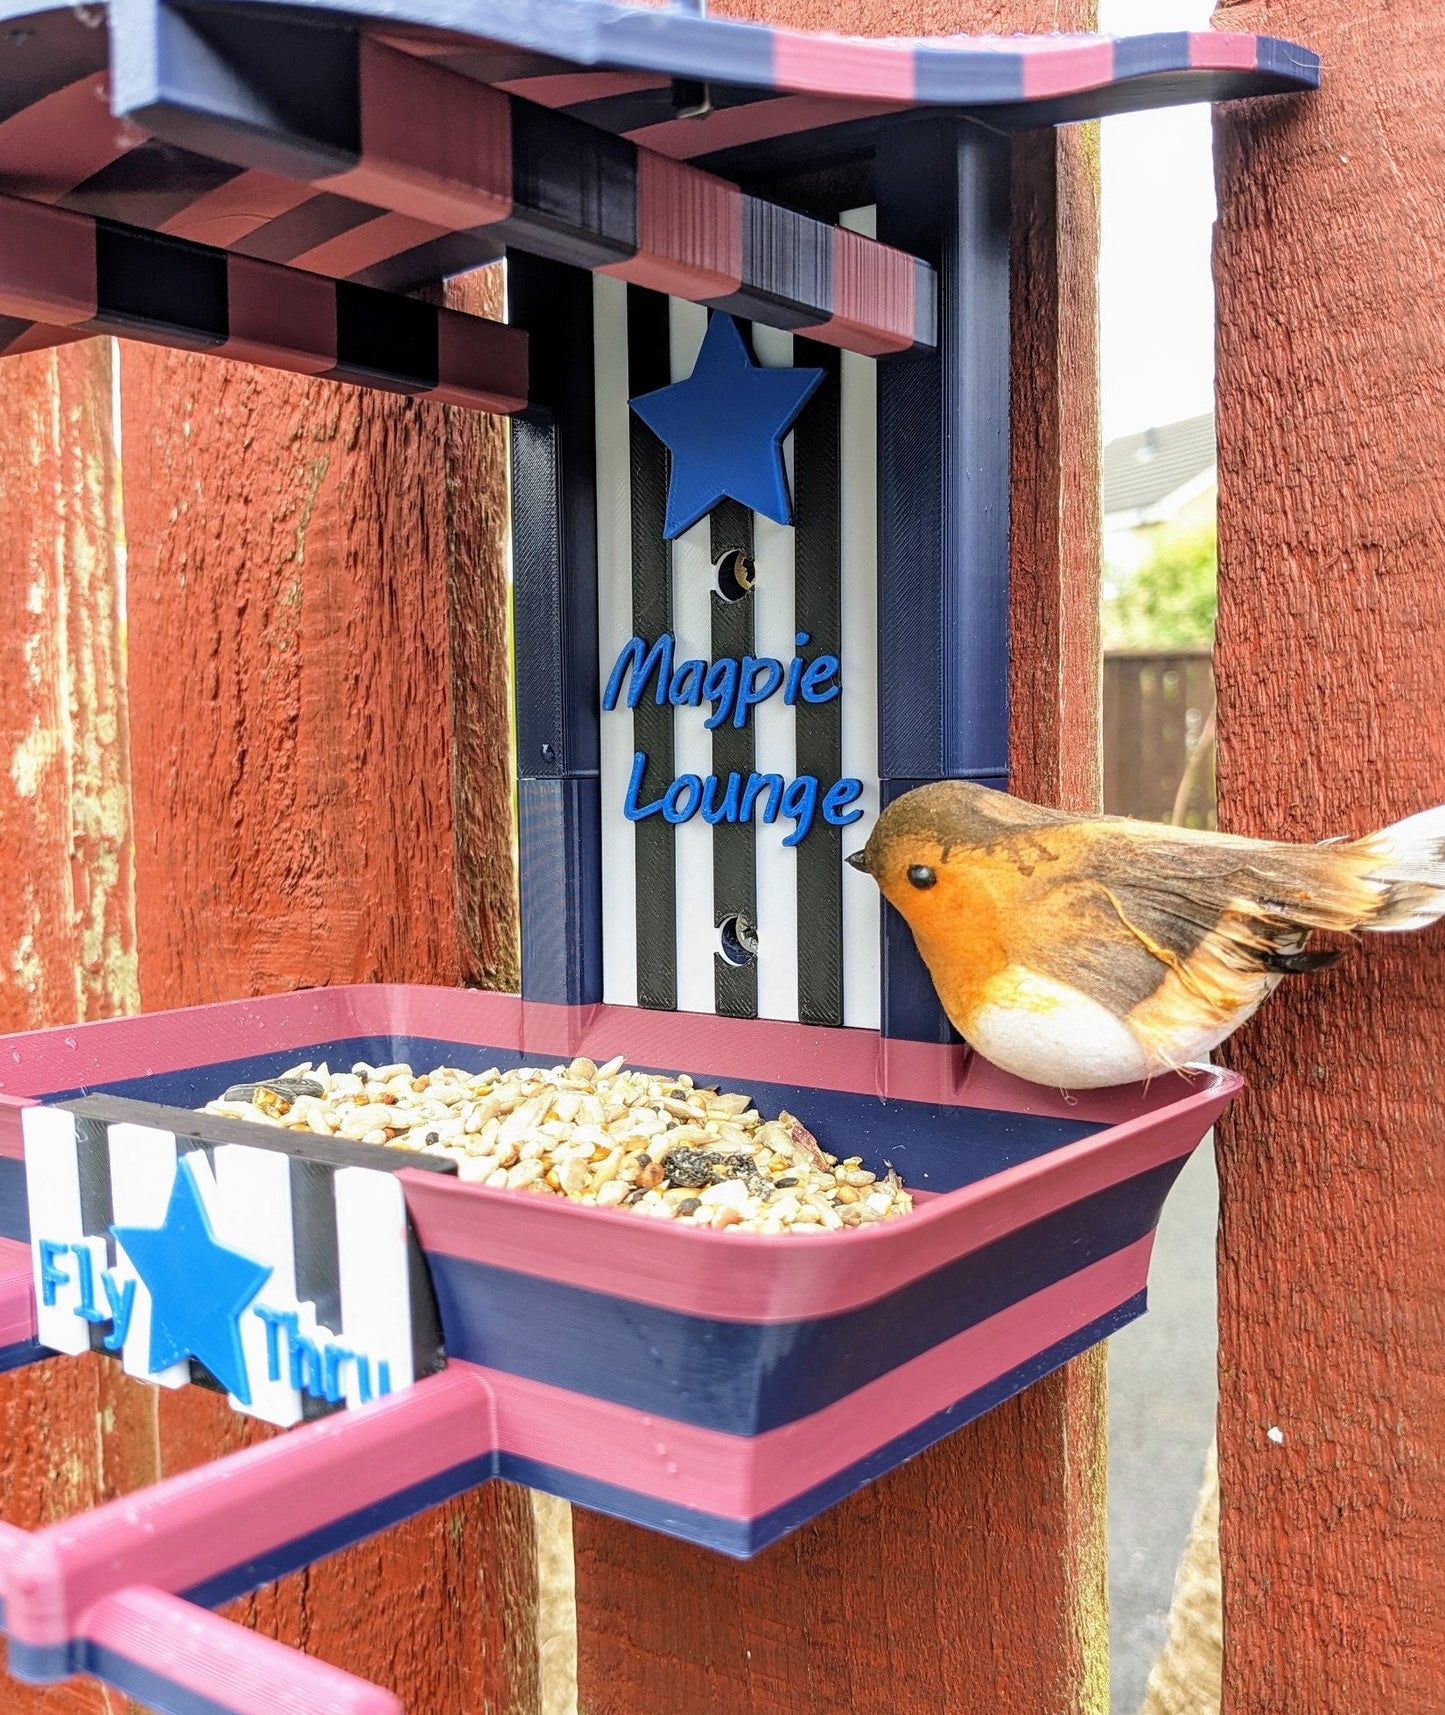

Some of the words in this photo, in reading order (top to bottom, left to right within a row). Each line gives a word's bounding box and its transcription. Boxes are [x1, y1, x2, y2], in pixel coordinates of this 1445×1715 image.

[602, 631, 842, 729] Magpie
[624, 751, 864, 847] Lounge
[39, 1239, 137, 1350] Fly
